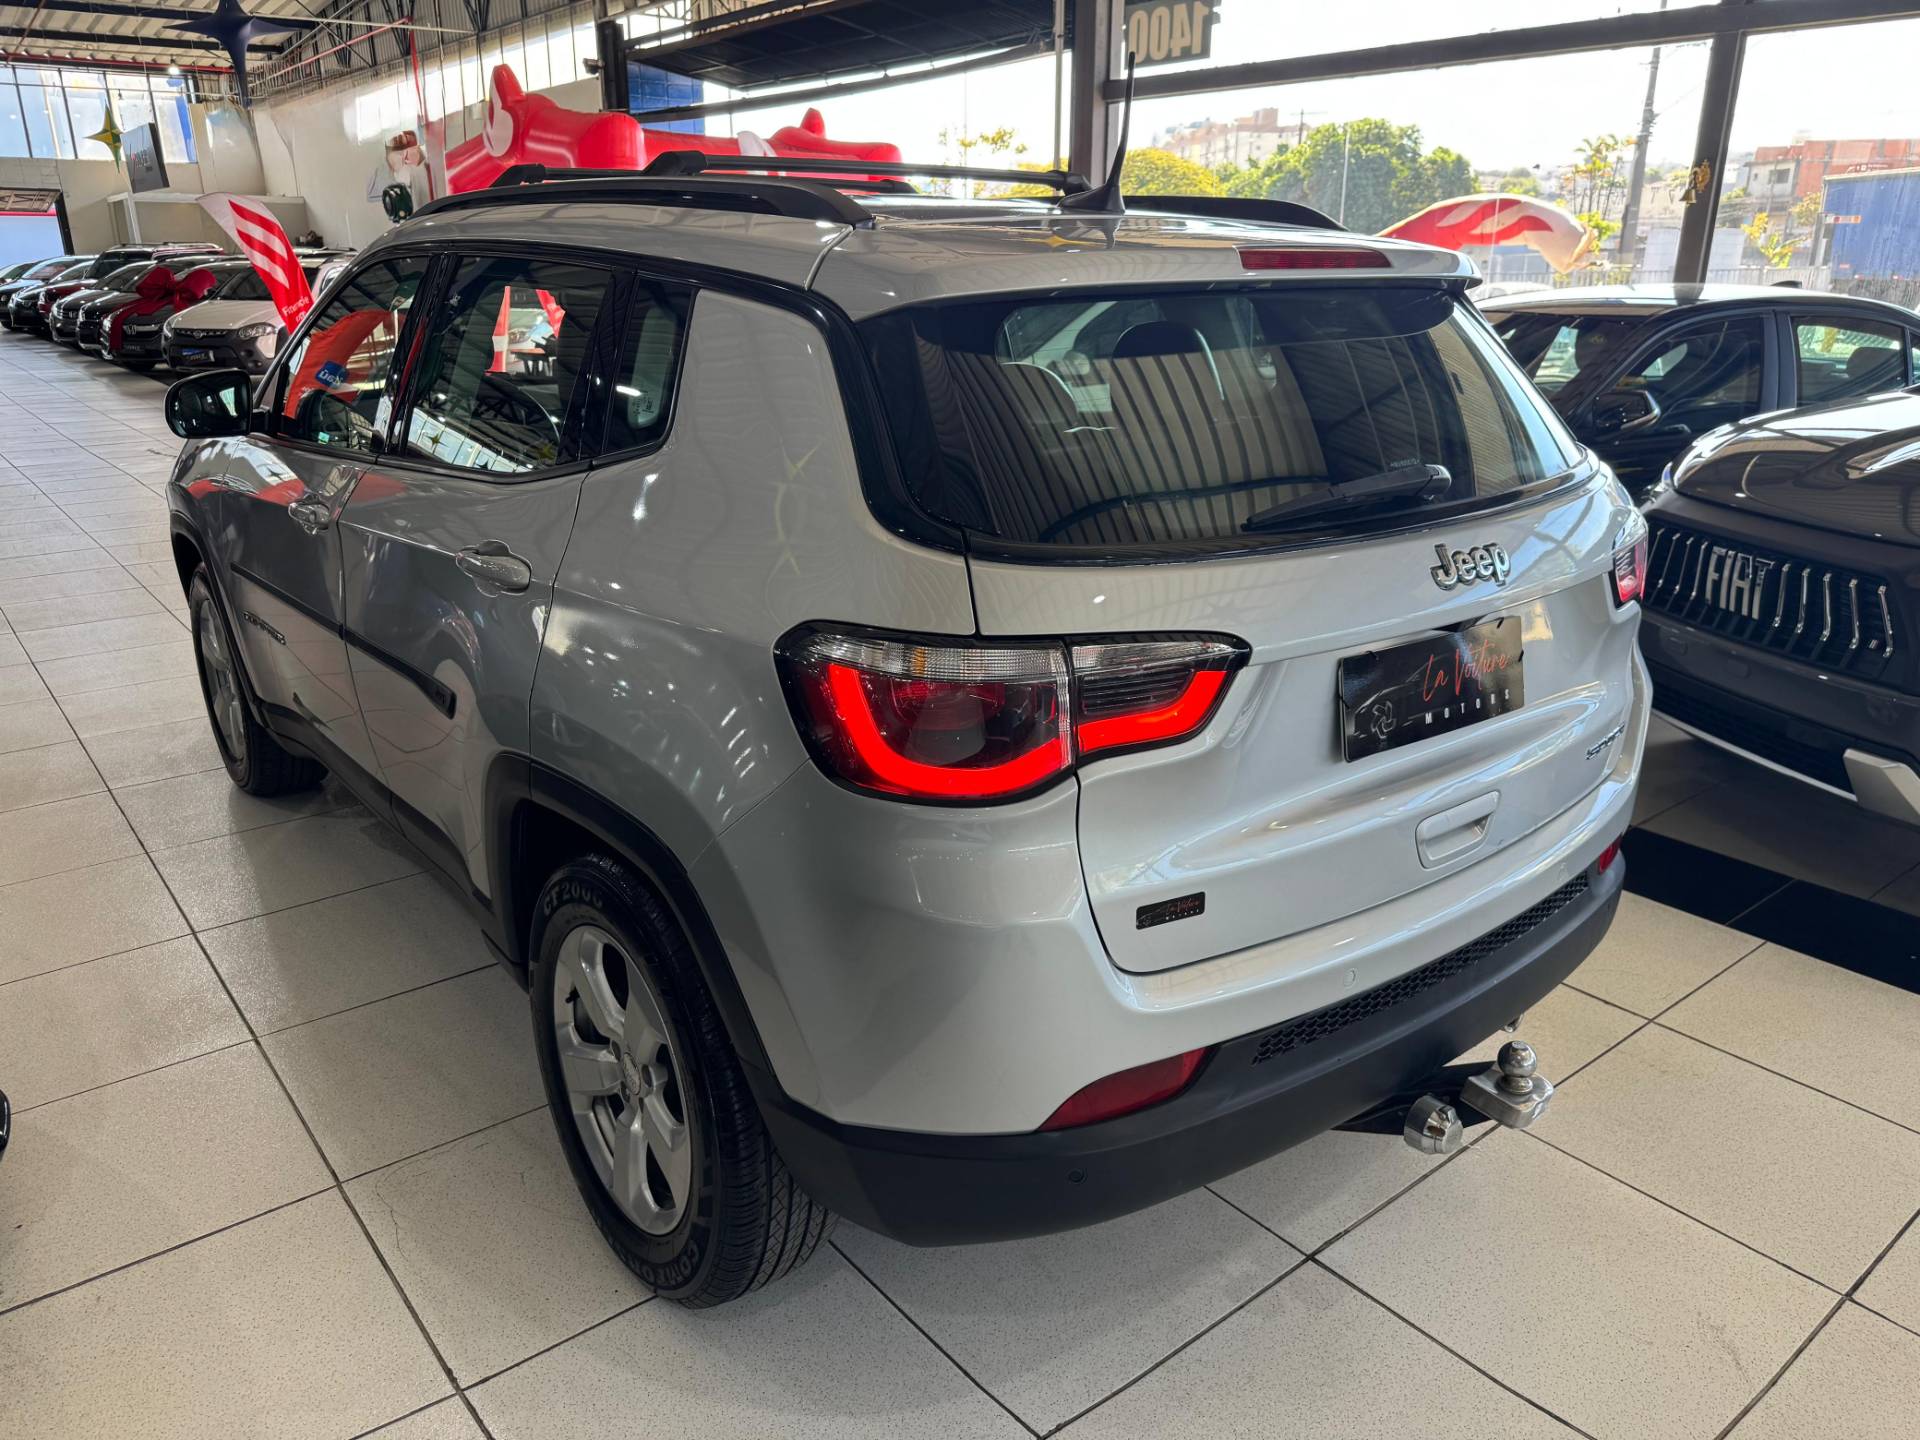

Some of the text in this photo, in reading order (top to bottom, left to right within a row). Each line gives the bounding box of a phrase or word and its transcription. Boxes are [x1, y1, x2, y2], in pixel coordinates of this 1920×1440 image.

[1431, 543, 1511, 591] Jeep
[1704, 546, 1775, 620] FIAT
[1422, 639, 1512, 702] La Voiture
[1424, 688, 1512, 725] MOTORS
